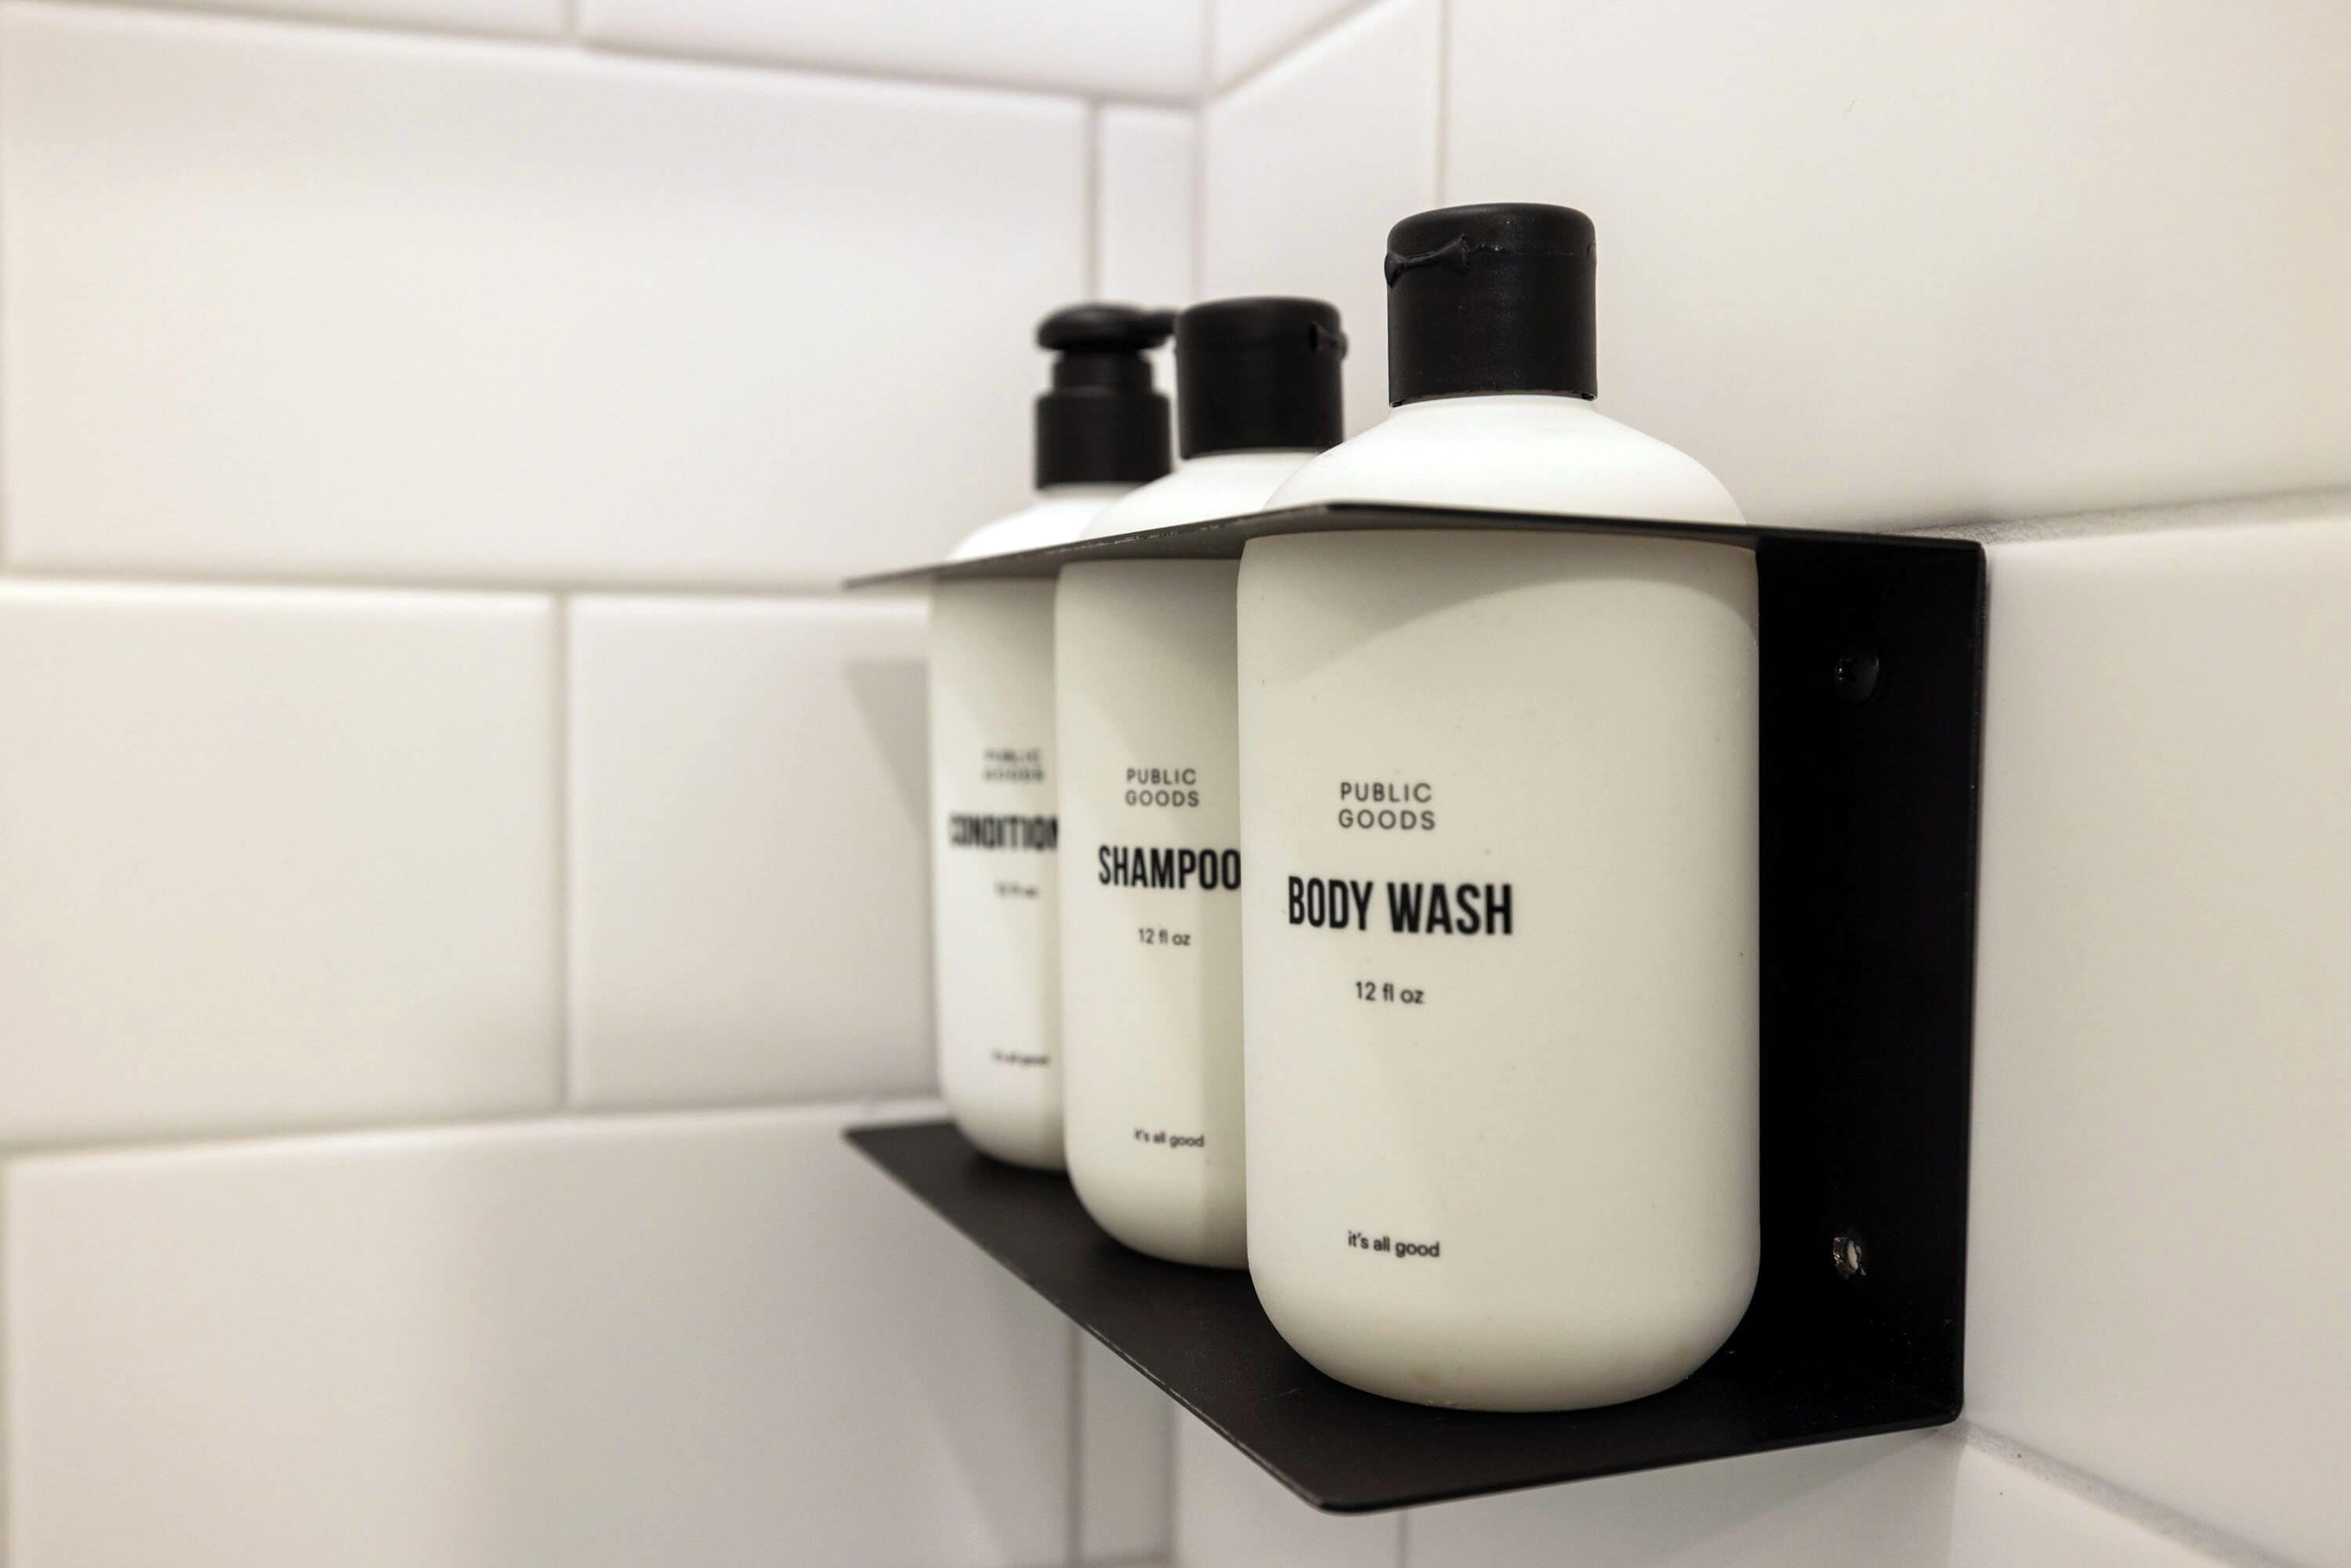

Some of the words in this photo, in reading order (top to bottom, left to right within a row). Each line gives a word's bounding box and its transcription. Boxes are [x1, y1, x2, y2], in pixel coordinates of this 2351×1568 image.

[1126, 767, 1197, 786] PUBLIC
[1124, 789, 1200, 808] GOODS
[1339, 781, 1432, 803] PUBLIC
[1338, 808, 1436, 831] GOODS
[1099, 845, 1241, 890] SHAMPOO
[1288, 875, 1374, 931] BODY
[1386, 882, 1513, 936] WASH
[1139, 927, 1155, 944] 12
[1158, 929, 1168, 944] fl
[1172, 933, 1191, 947] oz
[1356, 980, 1377, 1001] 12
[1382, 982, 1395, 1002] fl
[1400, 988, 1425, 1005] oz
[1169, 1134, 1205, 1149] good
[1347, 1230, 1369, 1250] it's
[1373, 1236, 1390, 1252] all
[1395, 1240, 1440, 1258] good
